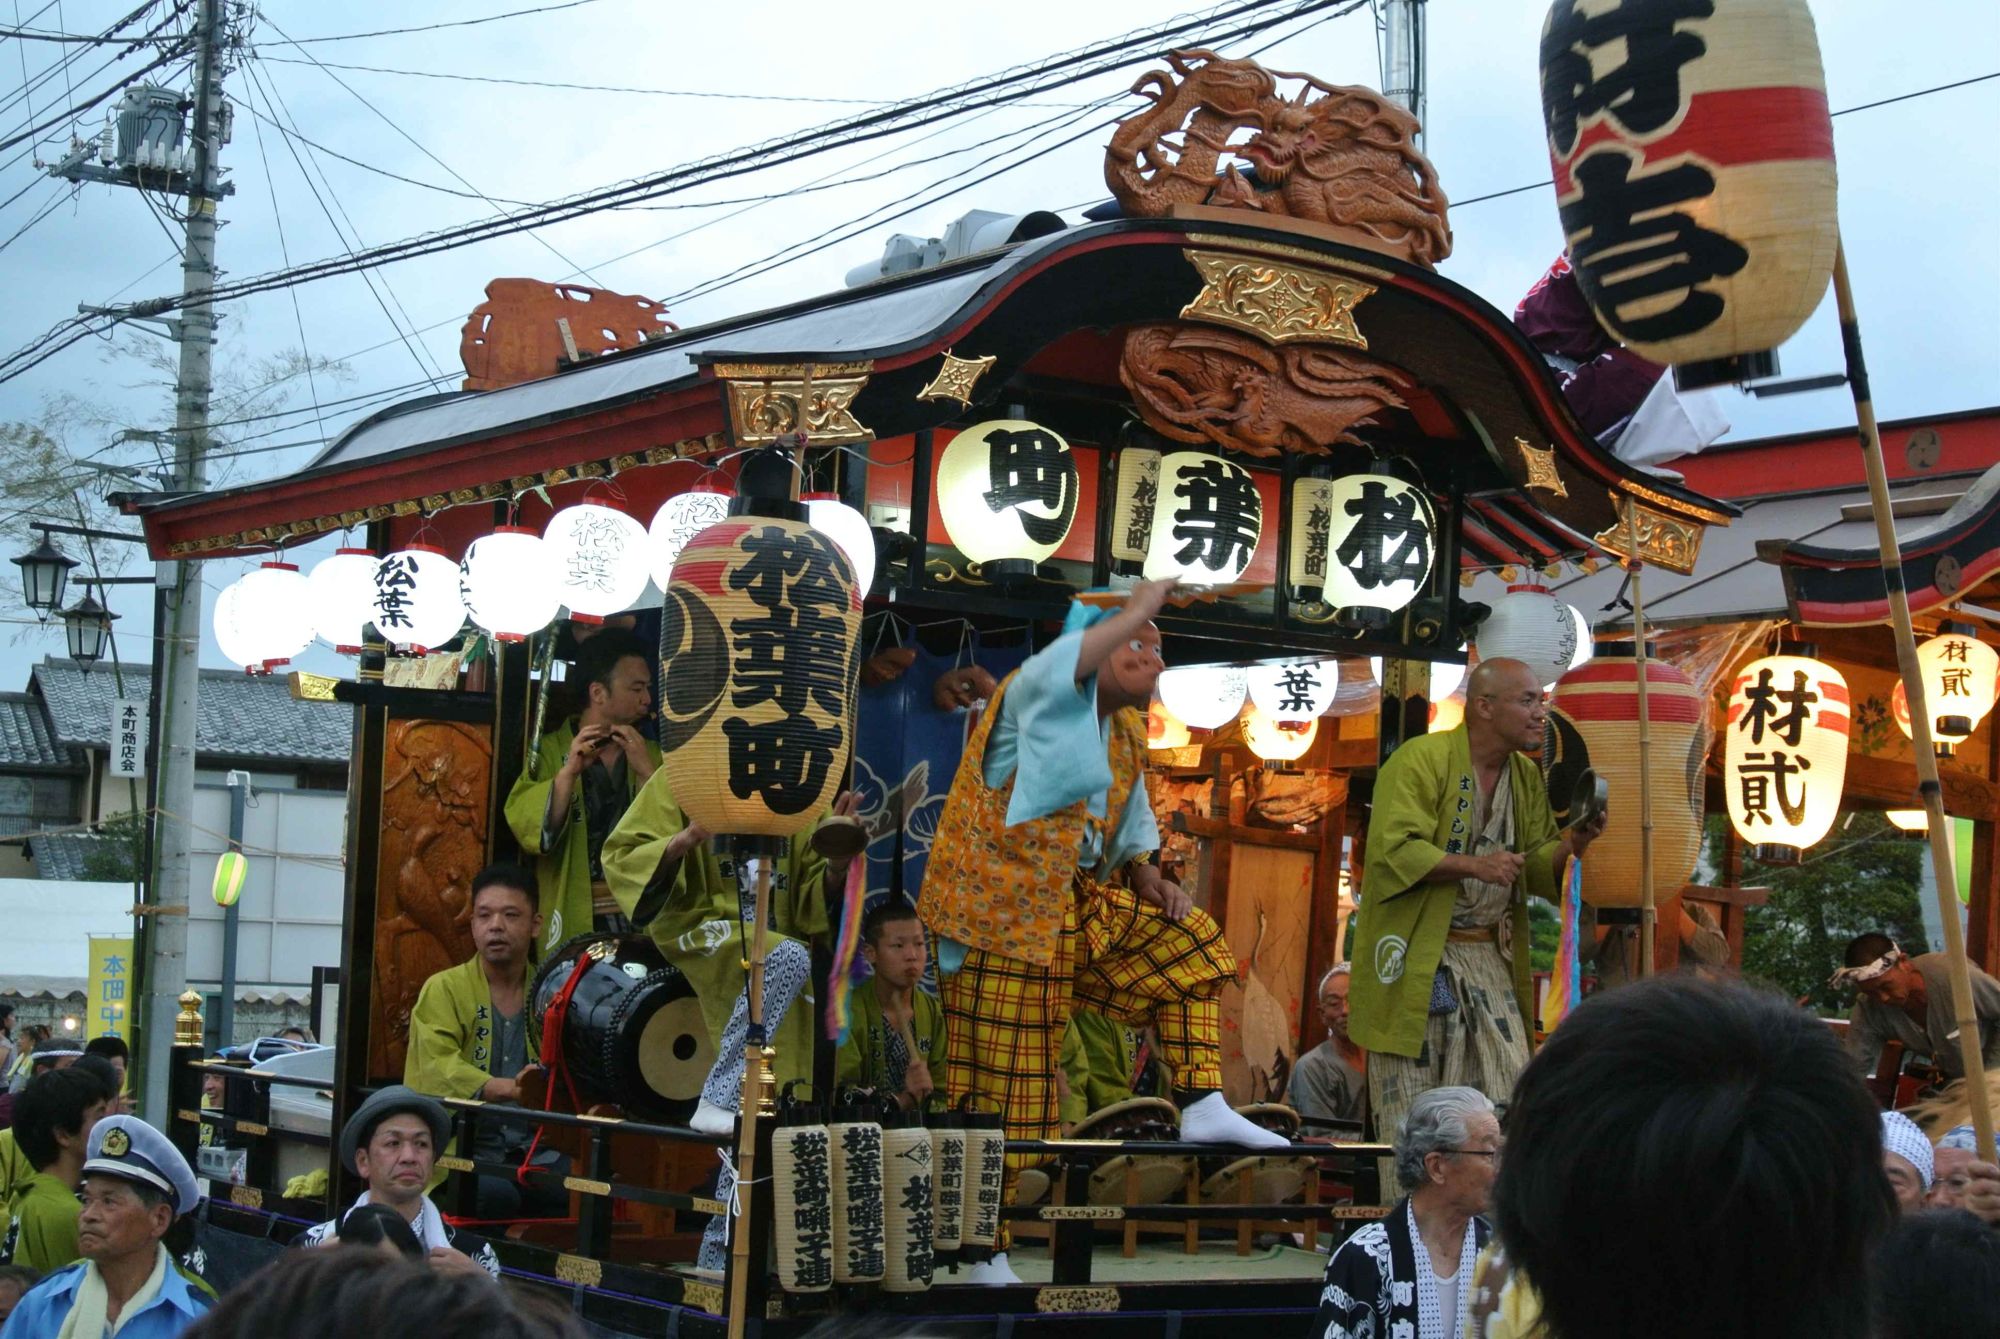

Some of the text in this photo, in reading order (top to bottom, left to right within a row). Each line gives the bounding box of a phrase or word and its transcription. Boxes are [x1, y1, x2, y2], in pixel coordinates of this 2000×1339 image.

[982, 428, 1079, 545] 町
[1173, 460, 1262, 574] 葉
[566, 511, 631, 593] 松葉
[1336, 481, 1437, 591] 松
[373, 555, 420, 629] 松葉
[721, 525, 853, 816] 松葉町
[1274, 662, 1322, 712] 葉
[120, 704, 138, 773] 本町商店会
[475, 1005, 490, 1072] はやし
